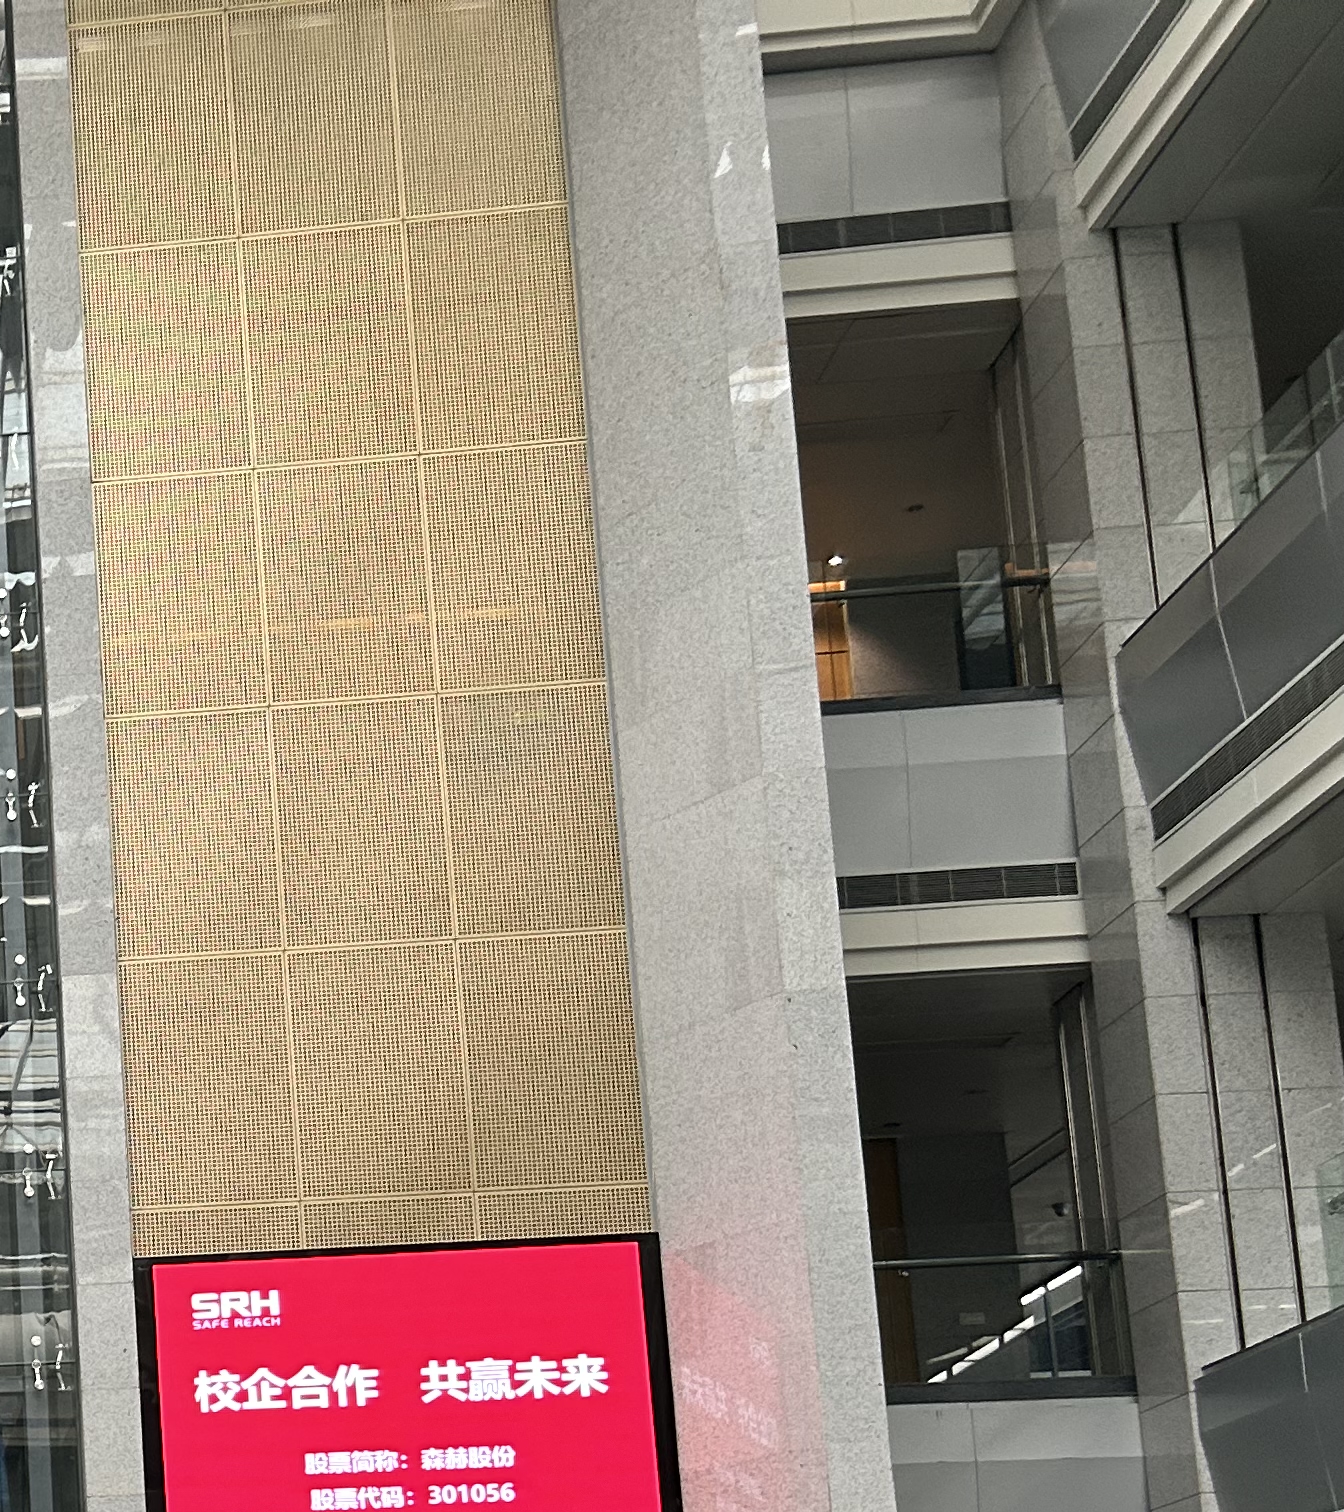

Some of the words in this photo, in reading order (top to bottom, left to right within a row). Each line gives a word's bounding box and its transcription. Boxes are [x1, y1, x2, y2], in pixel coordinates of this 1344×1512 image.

[190, 1289, 281, 1320] SRH
[192, 1319, 229, 1331] SAFE
[233, 1317, 281, 1329] REACH
[193, 1363, 380, 1414] 校企合作
[419, 1353, 610, 1405] 共赢未来
